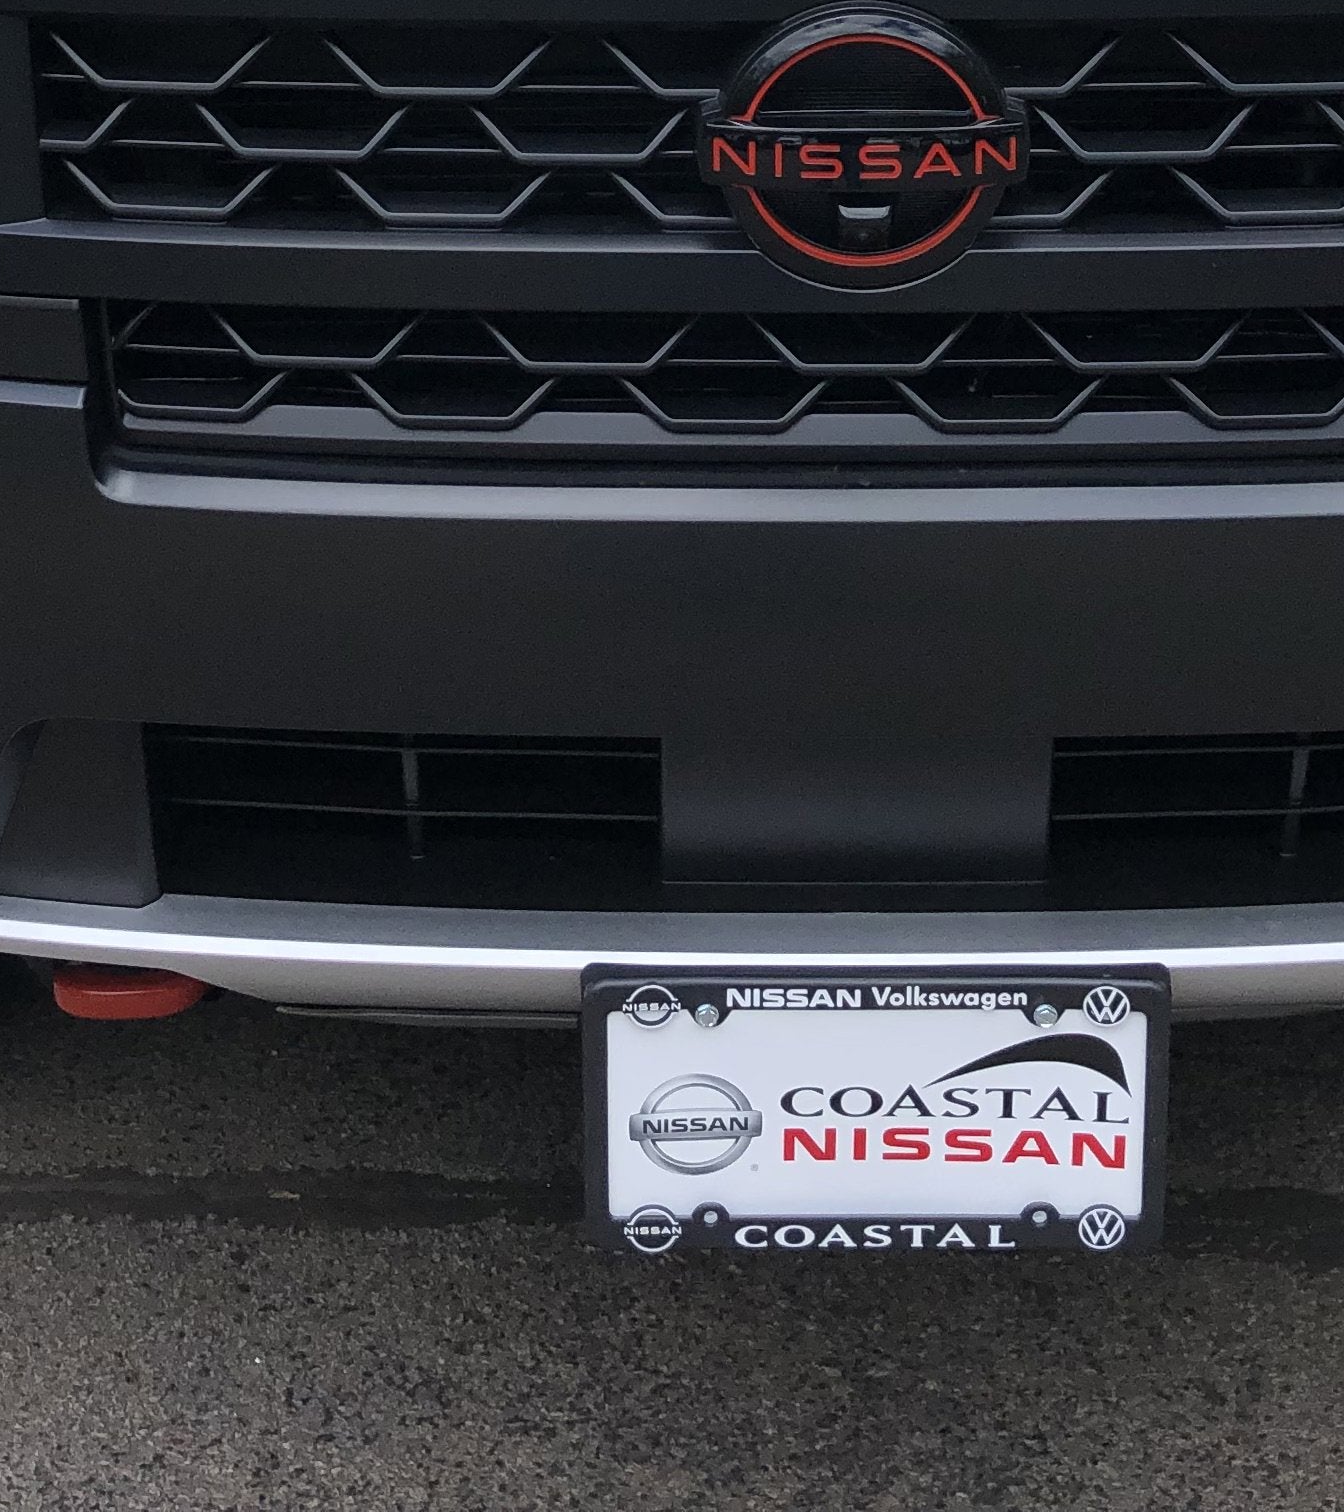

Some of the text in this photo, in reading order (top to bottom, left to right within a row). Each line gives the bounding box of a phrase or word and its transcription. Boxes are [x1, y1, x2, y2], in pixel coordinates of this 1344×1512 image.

[711, 136, 1017, 180] NISSAN
[622, 1002, 682, 1012] NISSAN
[726, 986, 1028, 1010] NISSAN Volkswagen
[780, 1085, 1130, 1124] COASTAL
[642, 1116, 750, 1135] NISSAN
[783, 1127, 1127, 1170] NISSAN
[623, 1226, 683, 1236] NISSAN
[734, 1223, 1016, 1249] COASTAL
